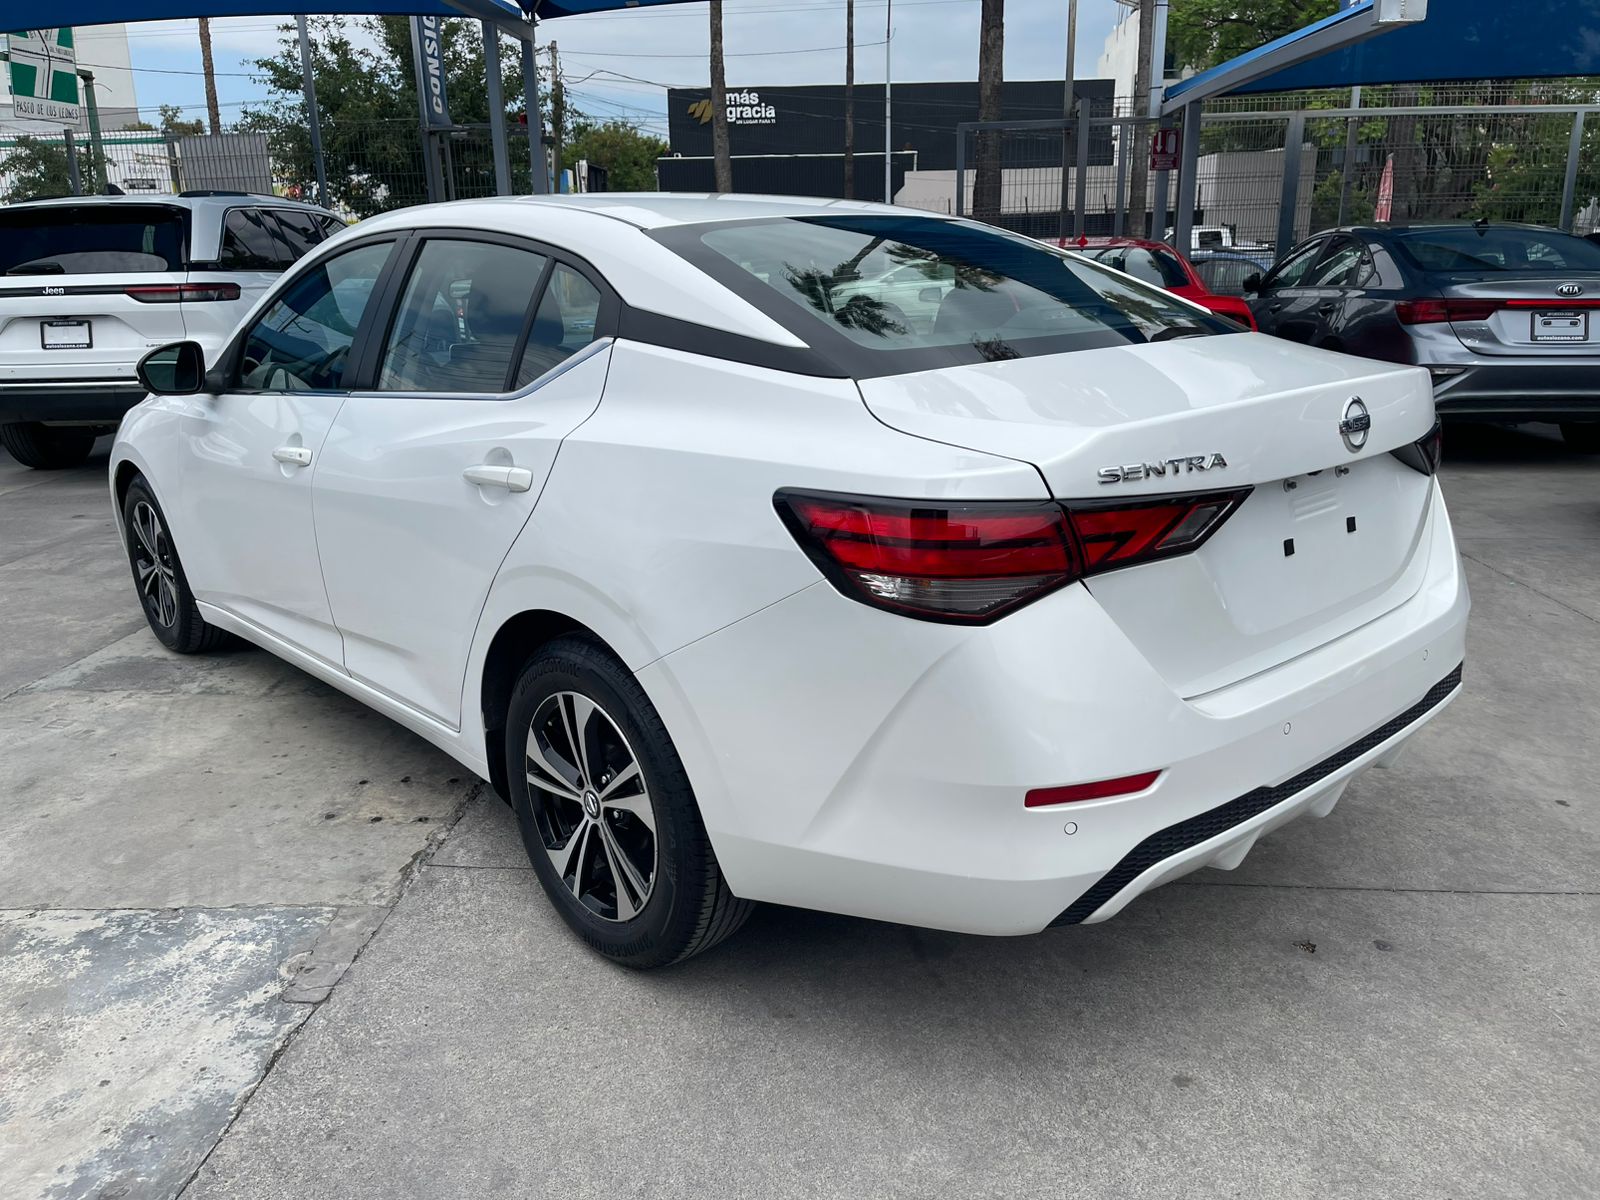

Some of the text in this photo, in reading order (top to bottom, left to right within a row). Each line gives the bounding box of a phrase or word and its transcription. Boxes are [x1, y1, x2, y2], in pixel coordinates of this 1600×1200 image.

[725, 89, 759, 105] más
[16, 101, 79, 120] PASEO DE LOS LEONES
[726, 103, 776, 122] gracia
[1562, 286, 1579, 294] KIA
[1097, 452, 1229, 485] SENTRA
